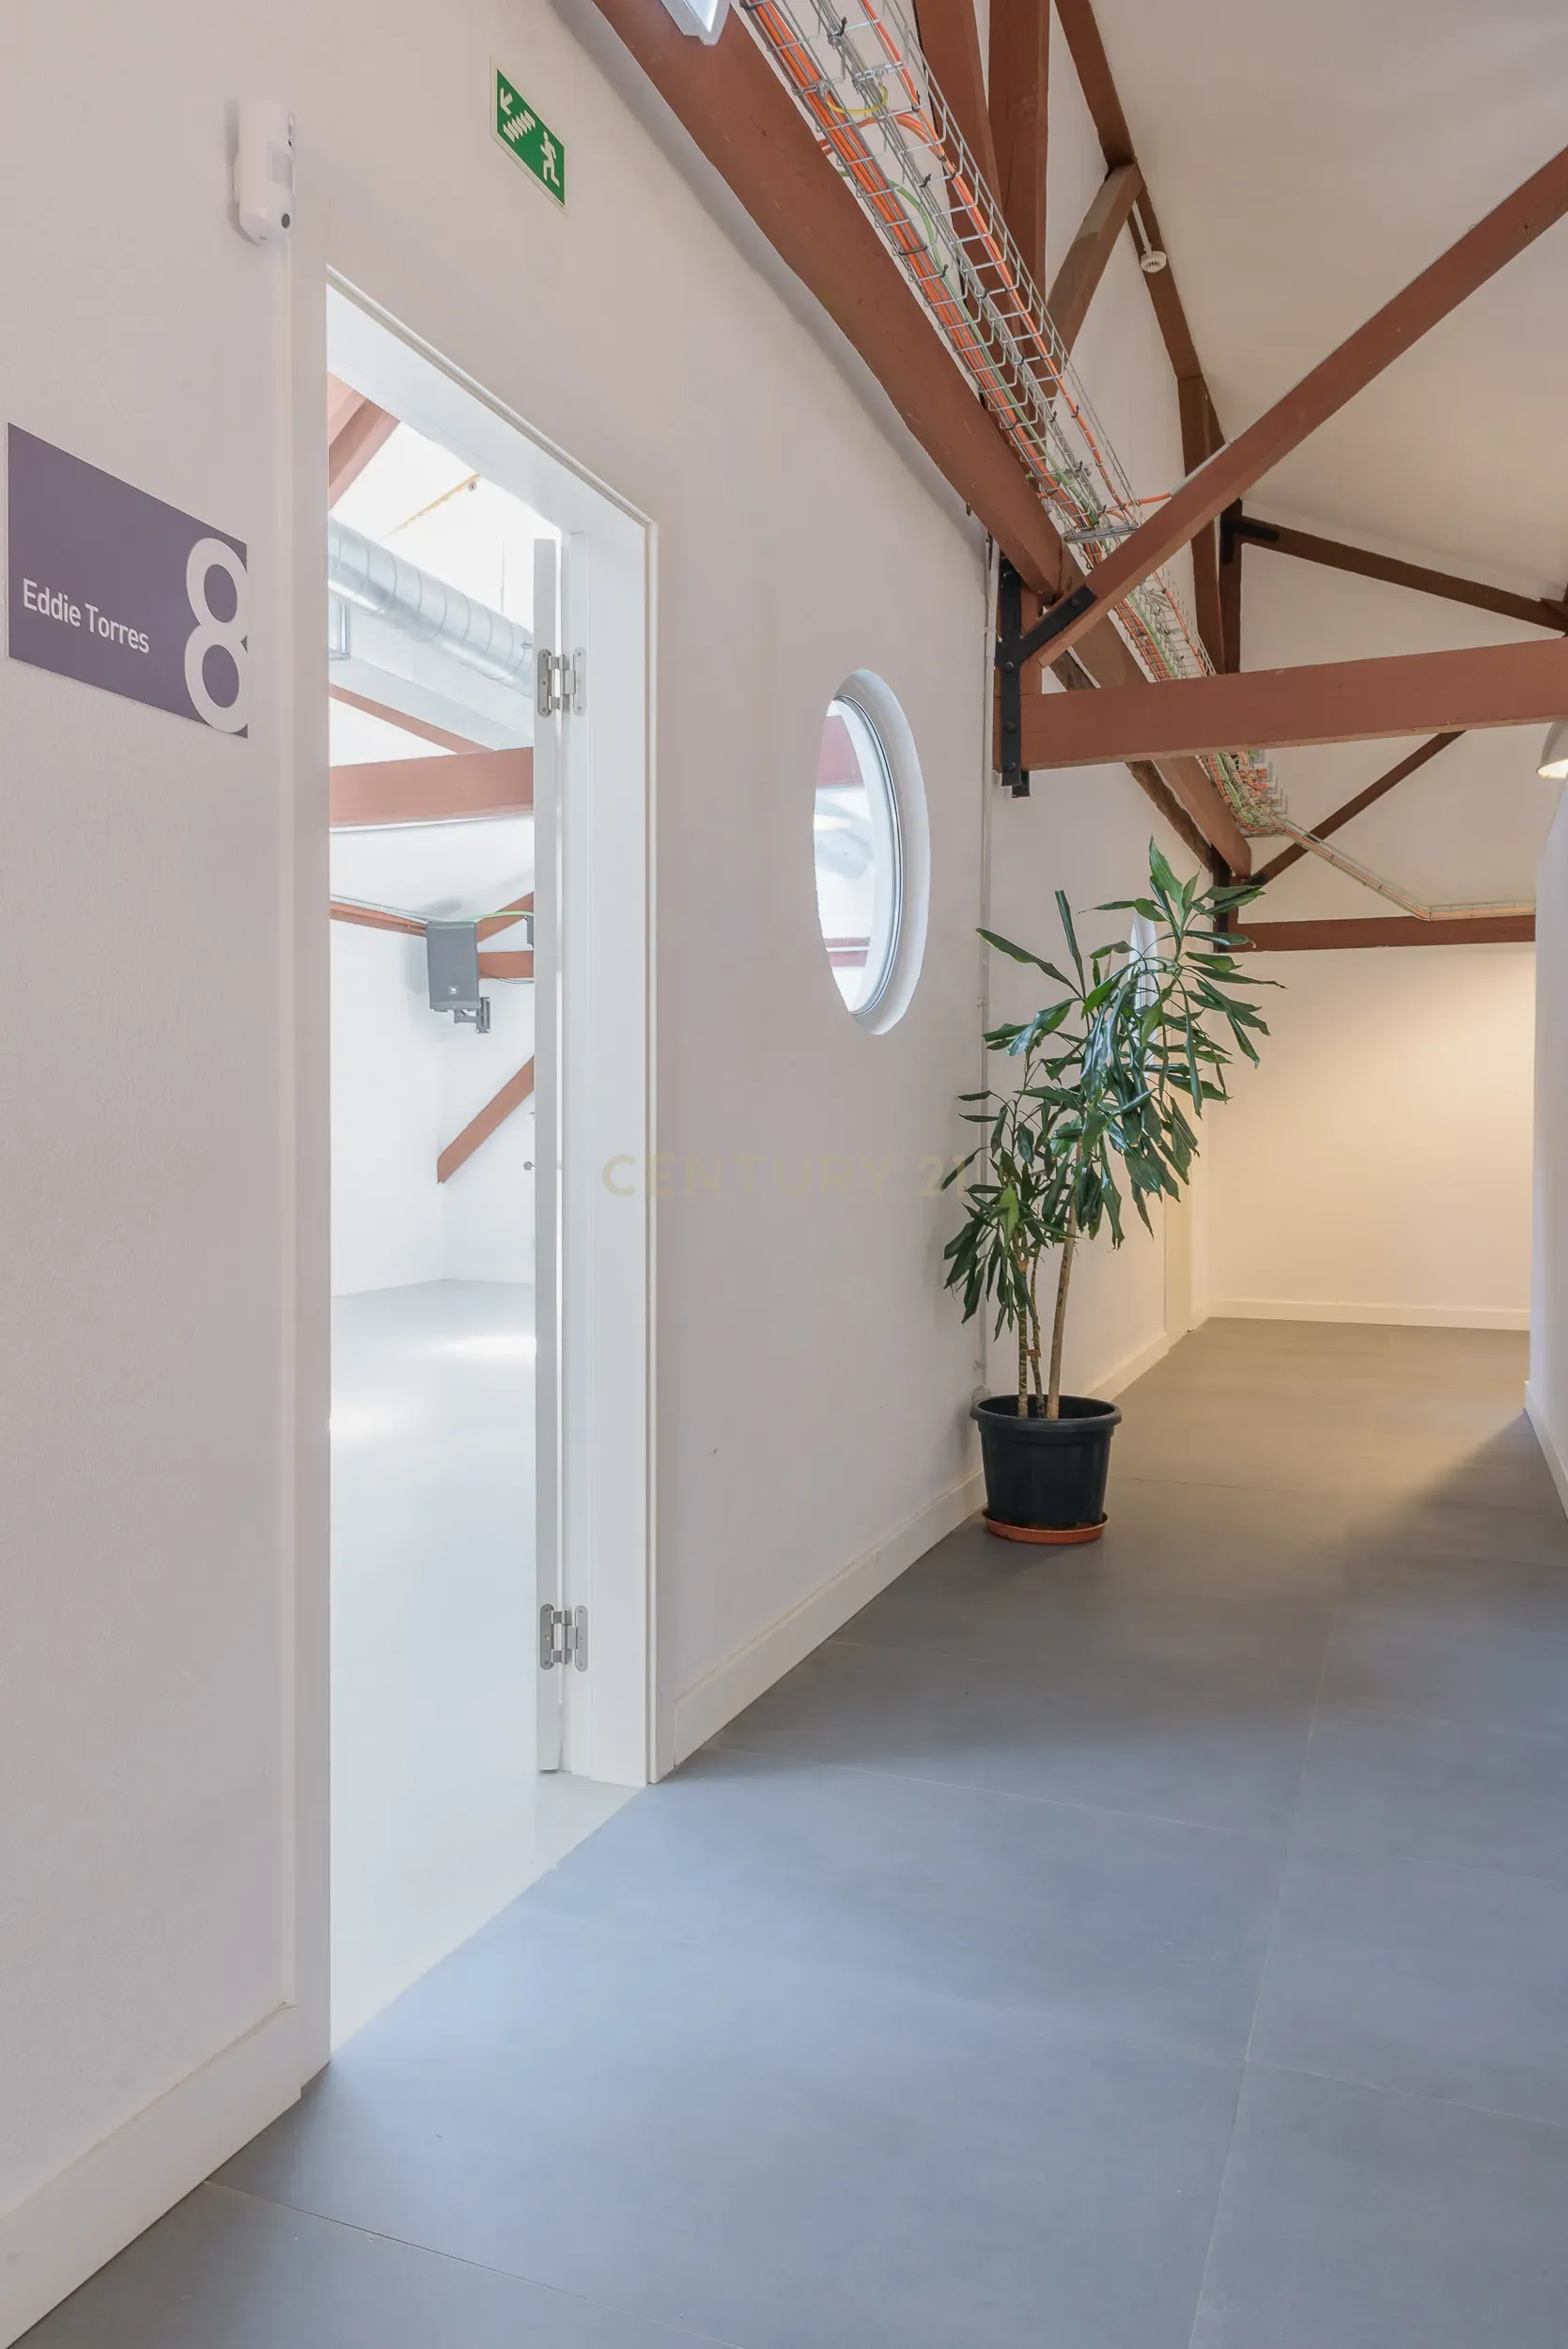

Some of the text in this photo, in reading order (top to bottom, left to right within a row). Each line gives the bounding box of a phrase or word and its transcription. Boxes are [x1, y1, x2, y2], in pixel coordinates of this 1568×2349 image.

[23, 578, 150, 654] Eddie Torres
[185, 537, 247, 733] 8
